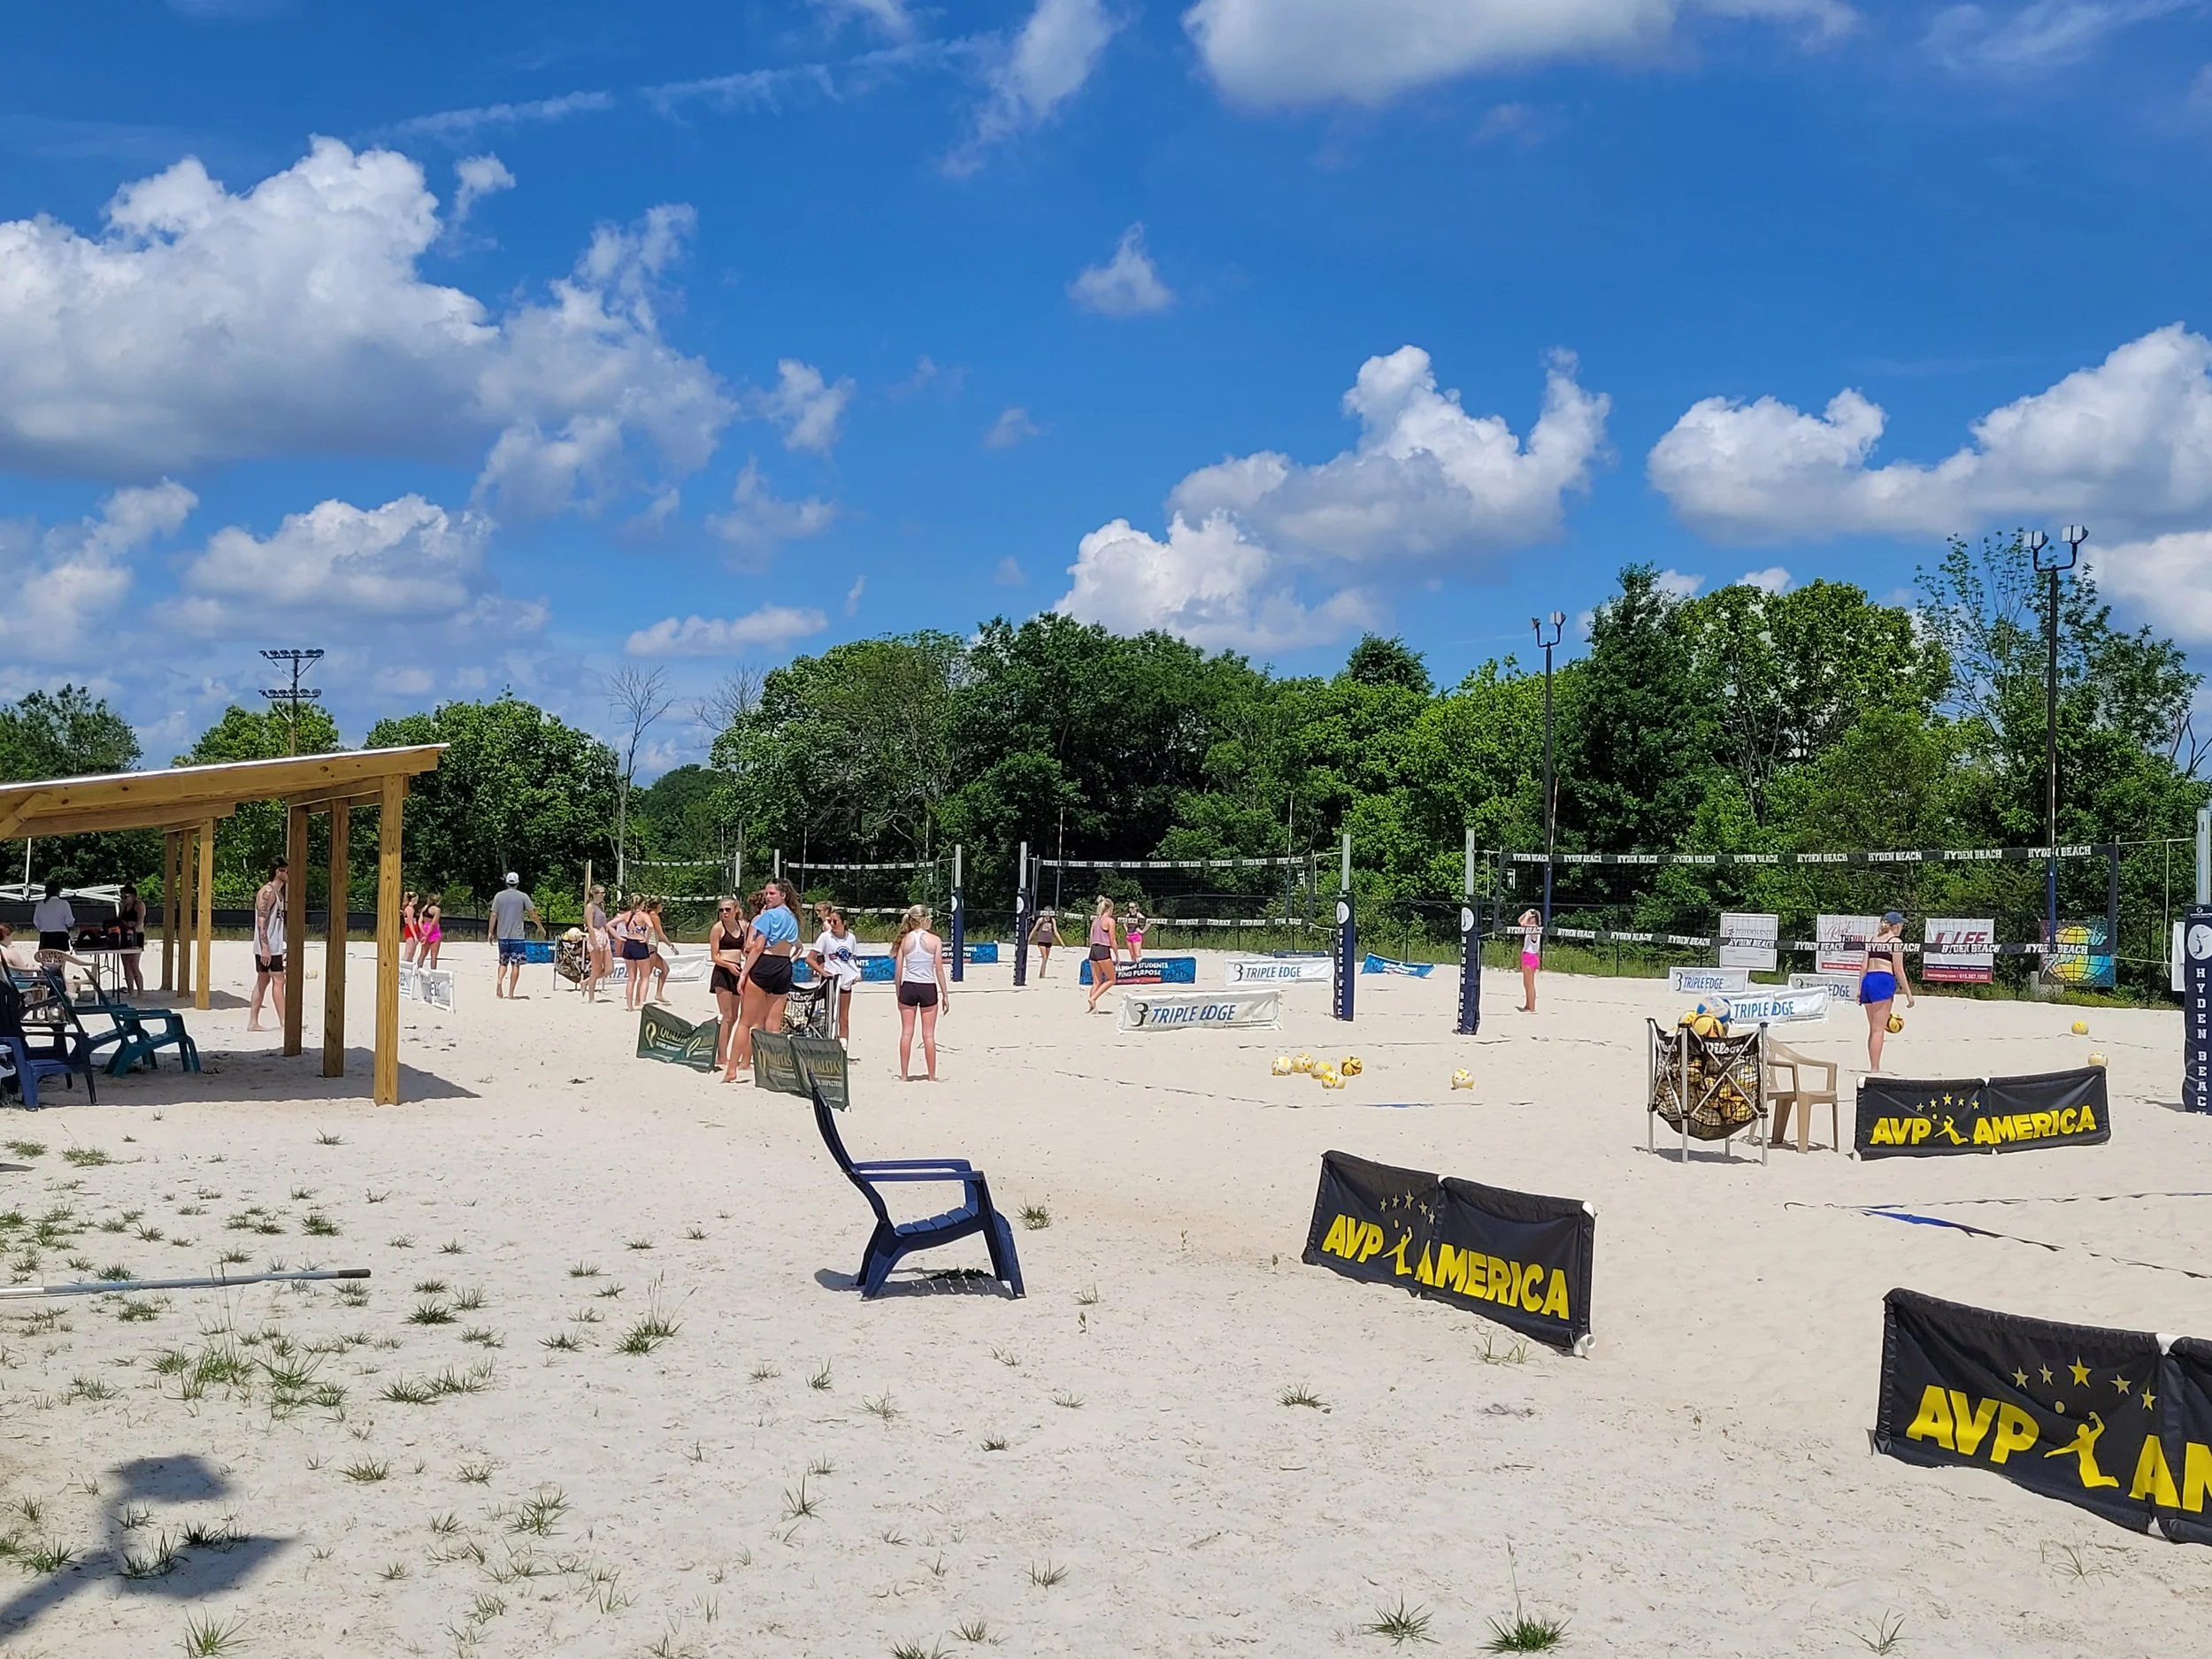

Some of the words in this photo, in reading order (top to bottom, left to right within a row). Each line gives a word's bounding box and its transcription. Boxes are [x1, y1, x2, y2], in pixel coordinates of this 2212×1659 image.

[1824, 853, 1848, 862] BEACH
[1868, 853, 1894, 862] HYDEN
[1895, 851, 1922, 861] BEACH
[1944, 850, 1973, 859] HYDEN
[1975, 849, 2002, 859] BEACH
[2028, 847, 2056, 857] HYD
[2062, 846, 2092, 856] BEACH
[1753, 939, 1775, 949] BEACH
[1820, 942, 1845, 951] BEACH
[1865, 942, 1893, 951] HYDEN
[1893, 943, 1921, 952] BEACH
[1971, 944, 2001, 953] BEACH
[2024, 944, 2051, 953] HYDE
[2057, 944, 2088, 954] BEACH
[1246, 966, 1277, 979] TRIPLE
[1279, 966, 1302, 977] EDGE
[1683, 976, 1704, 989] TRIPLE
[1705, 977, 1724, 990] EDGE
[1829, 983, 1850, 998] EDGE
[2196, 967, 2207, 1039] HYDEN
[1151, 1005, 1198, 1024] TRIPLE
[1199, 1004, 1236, 1020] EDGE
[1734, 1002, 1769, 1018] TRIPLE
[2197, 1051, 2208, 1115] BEAC
[1870, 1118, 1932, 1145] AVP
[1973, 1105, 2097, 1145] AMERICA
[1322, 1213, 1384, 1263] AVP
[1414, 1240, 1570, 1321] AMERICA
[1906, 1385, 2039, 1465] AVP
